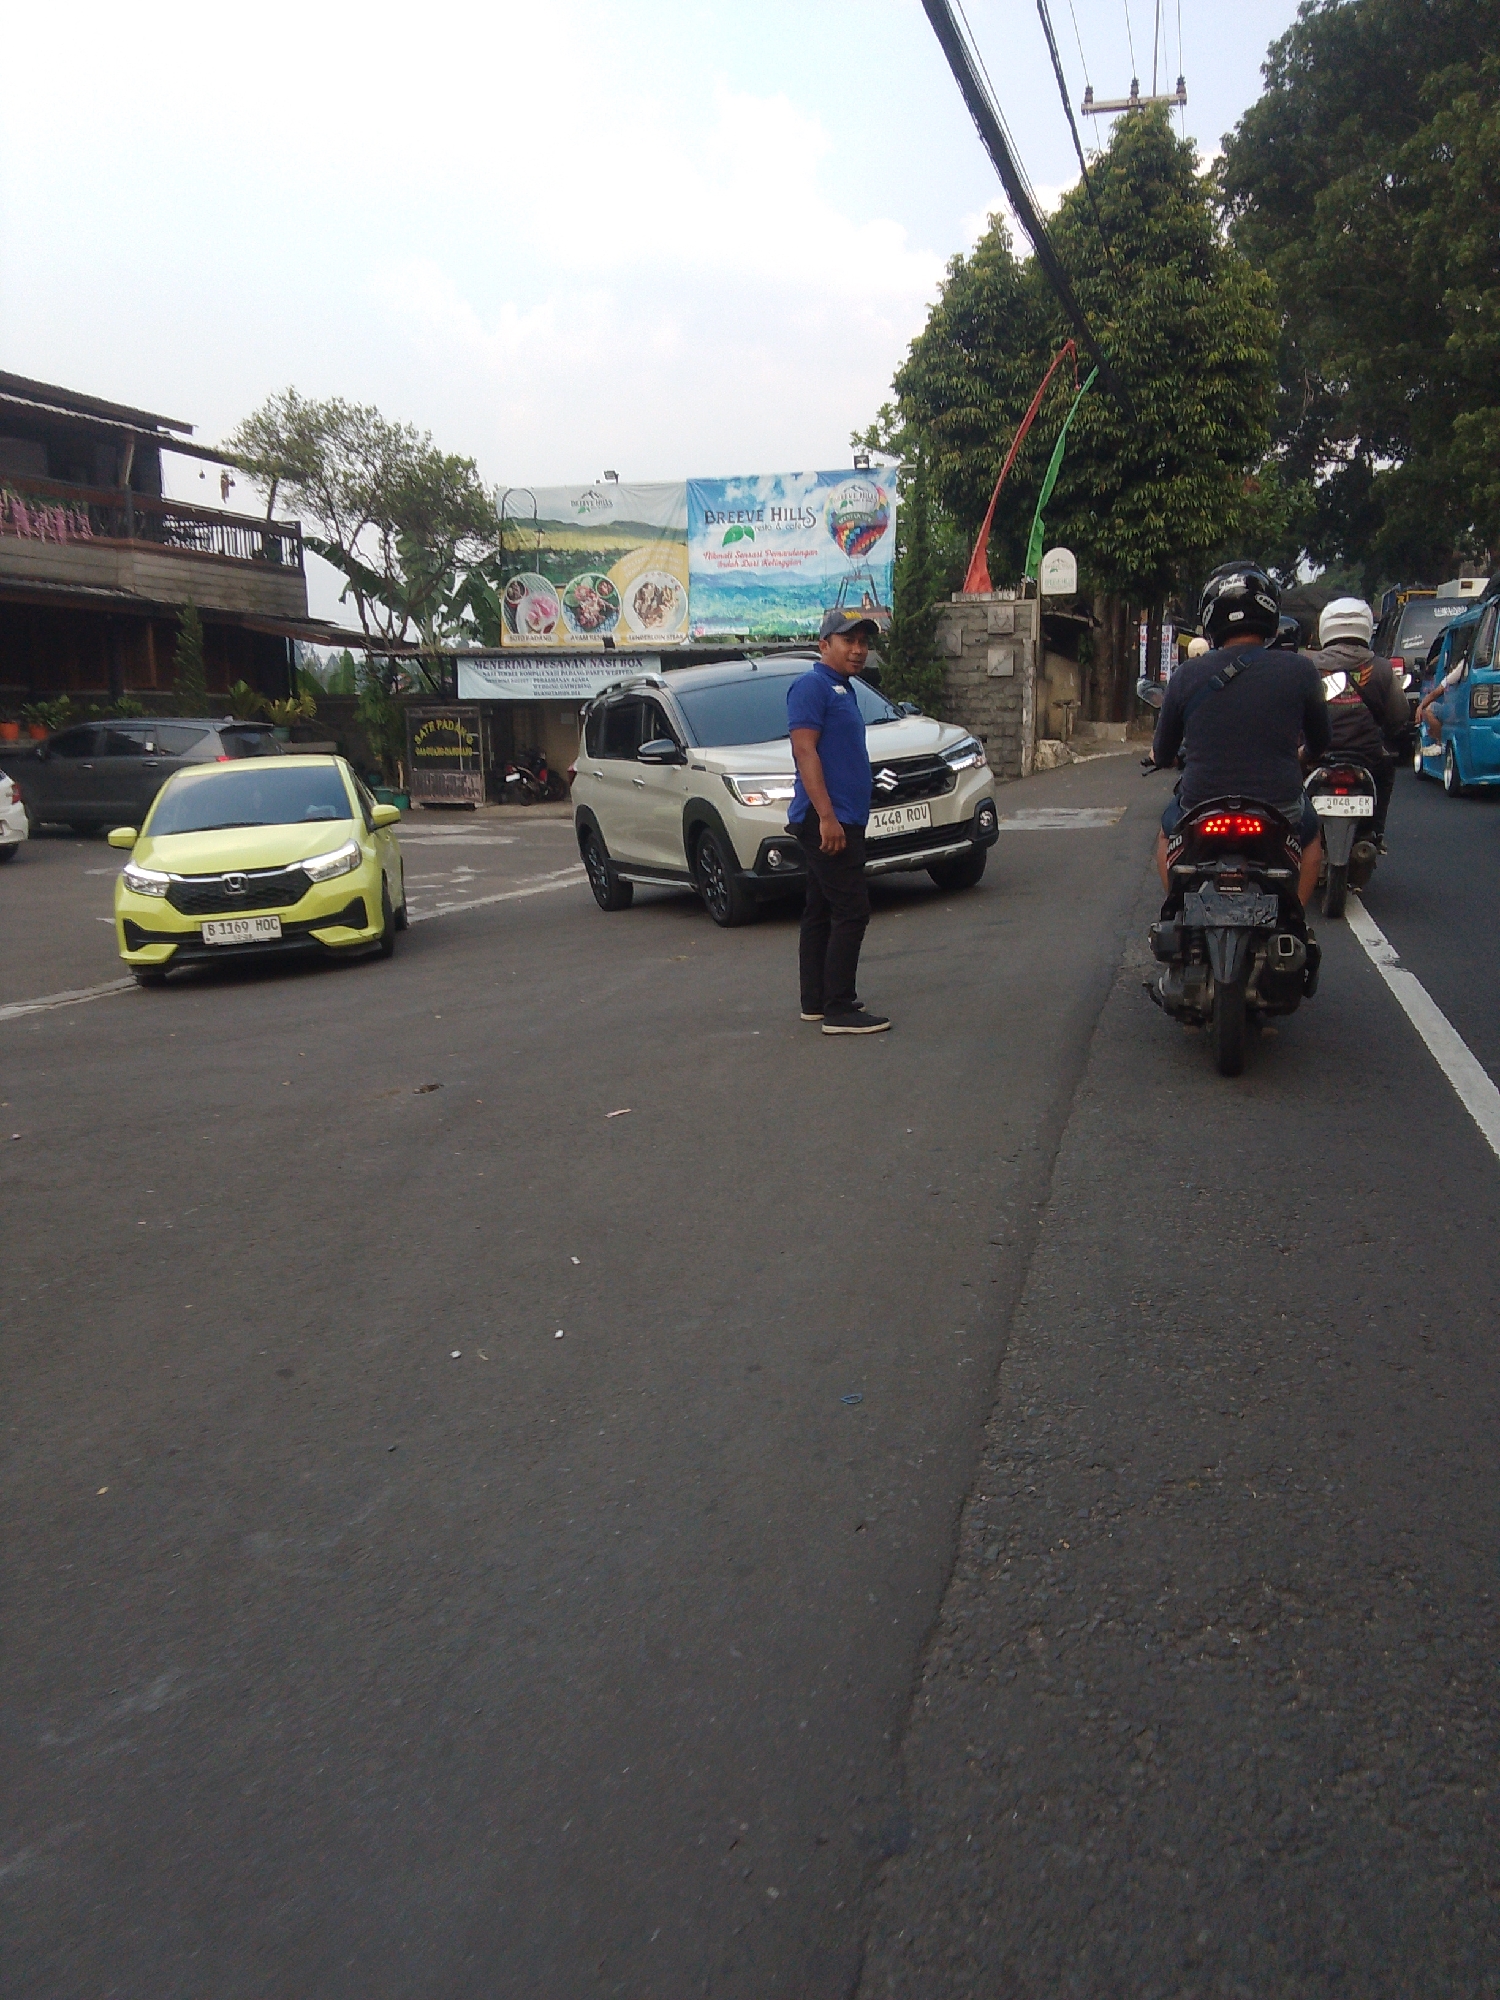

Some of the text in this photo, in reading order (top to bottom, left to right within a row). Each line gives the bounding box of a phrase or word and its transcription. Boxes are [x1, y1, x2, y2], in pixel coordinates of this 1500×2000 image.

[704, 509, 764, 525] BREEVE
[770, 506, 817, 529] HILLS
[754, 524, 773, 532] resto
[473, 657, 643, 670] MENERIMA PESANAN NASI BOX
[414, 719, 474, 745] SATE PADANG
[873, 805, 927, 828] 1448 ROV
[207, 918, 279, 937] B 1169 HOC
